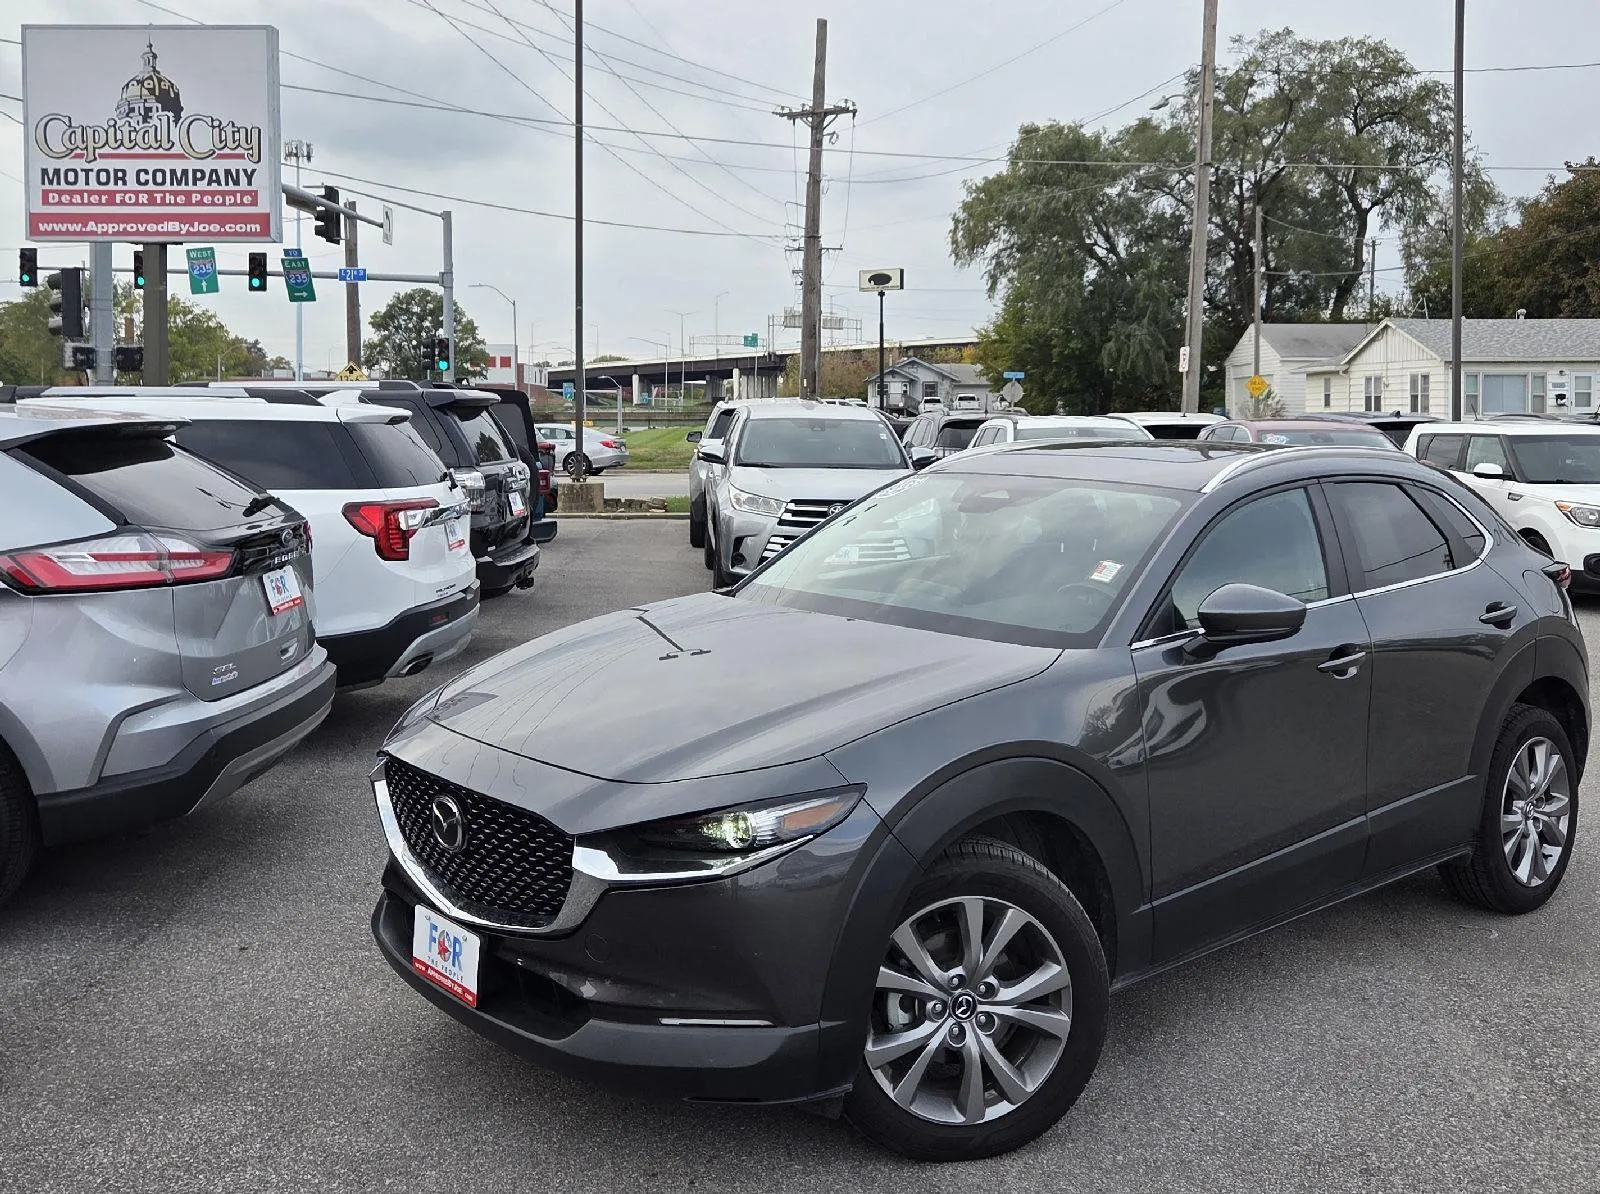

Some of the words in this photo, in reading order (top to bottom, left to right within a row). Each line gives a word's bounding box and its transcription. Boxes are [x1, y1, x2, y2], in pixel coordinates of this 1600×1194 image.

[35, 113, 174, 163] Capital
[178, 113, 262, 163] City
[41, 168, 127, 186] MOTOR
[136, 168, 257, 186] COMPANY
[48, 192, 108, 204] Dealer
[115, 192, 149, 204] FOR
[154, 192, 186, 204] The
[191, 192, 253, 206] People
[38, 221, 261, 235] www.ApprovedByJoe.com
[190, 250, 212, 259] WEST
[193, 263, 213, 275] 235
[289, 273, 308, 284] 235
[428, 922, 464, 973] FOR
